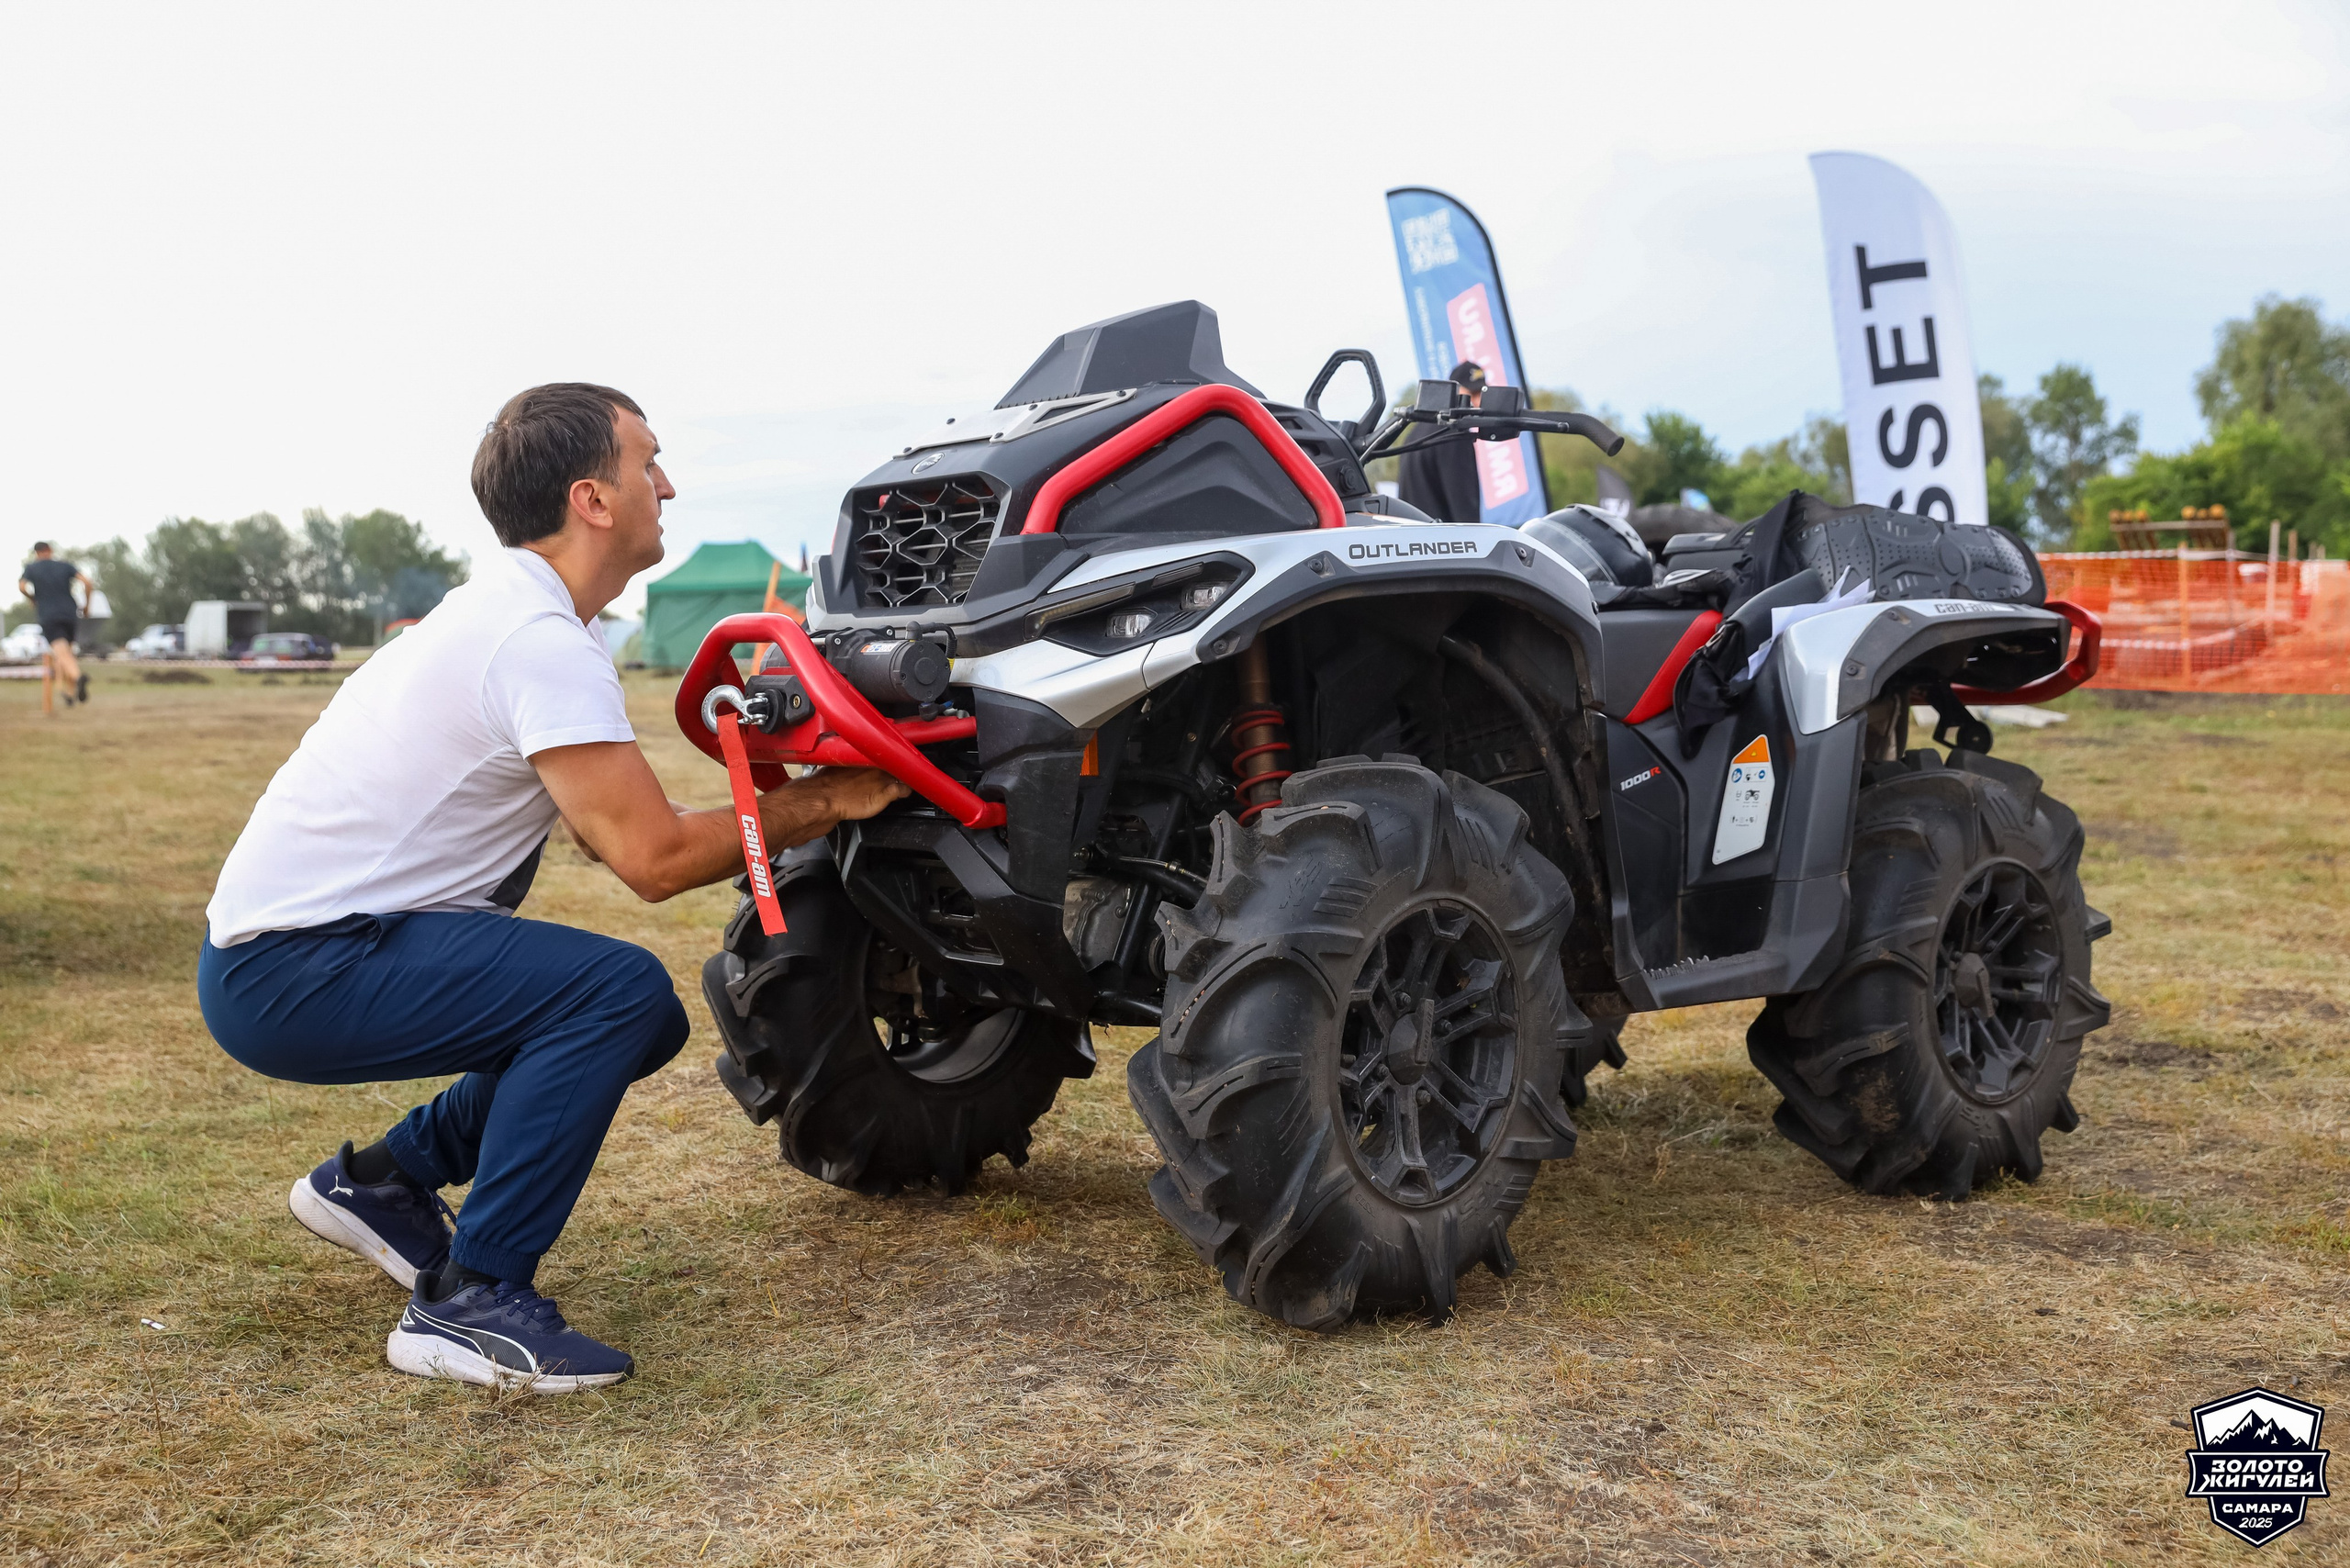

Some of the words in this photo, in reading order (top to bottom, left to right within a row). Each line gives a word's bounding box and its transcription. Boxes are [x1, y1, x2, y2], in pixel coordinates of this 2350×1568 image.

[1348, 541, 1478, 560] OUTLANDER
[1620, 766, 1662, 791] 1000R
[741, 814, 771, 898] can-am
